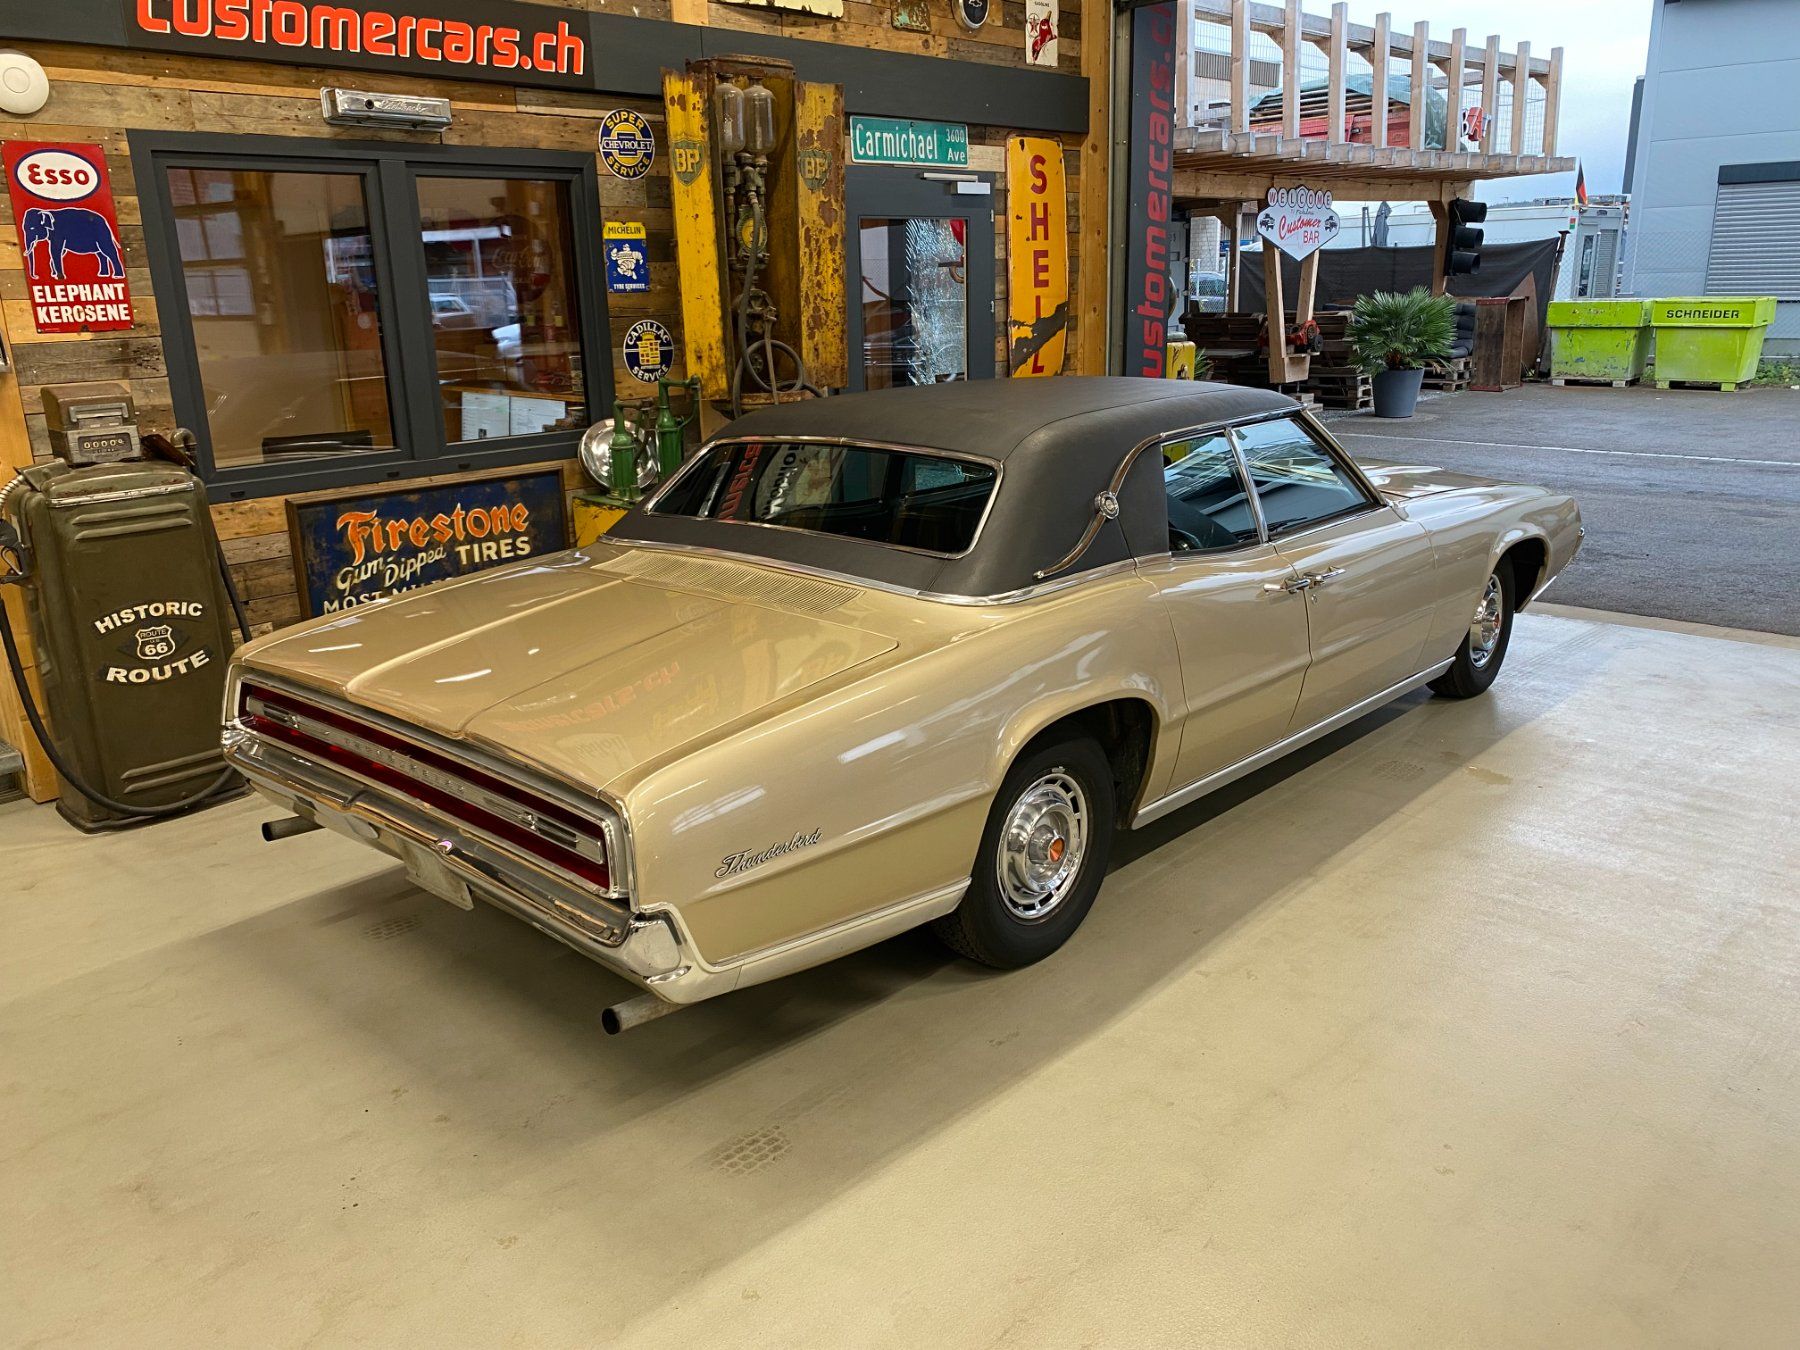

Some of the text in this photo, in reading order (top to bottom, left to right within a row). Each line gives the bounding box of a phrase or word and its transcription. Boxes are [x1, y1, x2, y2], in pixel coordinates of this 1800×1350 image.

[136, 0, 585, 76] customercars.ch
[605, 111, 645, 130] SUPER
[603, 139, 653, 150] CHEVROLET
[855, 123, 938, 160] Carmichael
[945, 128, 965, 143] 3600
[674, 148, 700, 172] BP
[947, 147, 966, 162] Ave
[606, 156, 650, 177] SERVICE
[805, 157, 828, 179] BP
[1137, 4, 1173, 379] ustomercars.c
[1268, 190, 1331, 207] WELCOME
[607, 226, 642, 235] MICHELIN
[1303, 230, 1320, 244] BAR
[32, 282, 125, 304] ELEPHANT
[36, 303, 131, 325] KEROSENE
[1666, 308, 1740, 320] SCHNEIDER
[627, 322, 670, 346] CADILLAC
[632, 363, 669, 381] SERVICE
[336, 502, 529, 567] Firestone
[384, 544, 447, 588] Dipped
[455, 536, 532, 566] TIRES
[94, 601, 203, 634] HISTORIC
[140, 628, 167, 639] ROUTE
[144, 642, 169, 656] 66
[106, 649, 210, 683] ROUTE
[714, 826, 823, 878] Thunderbird
